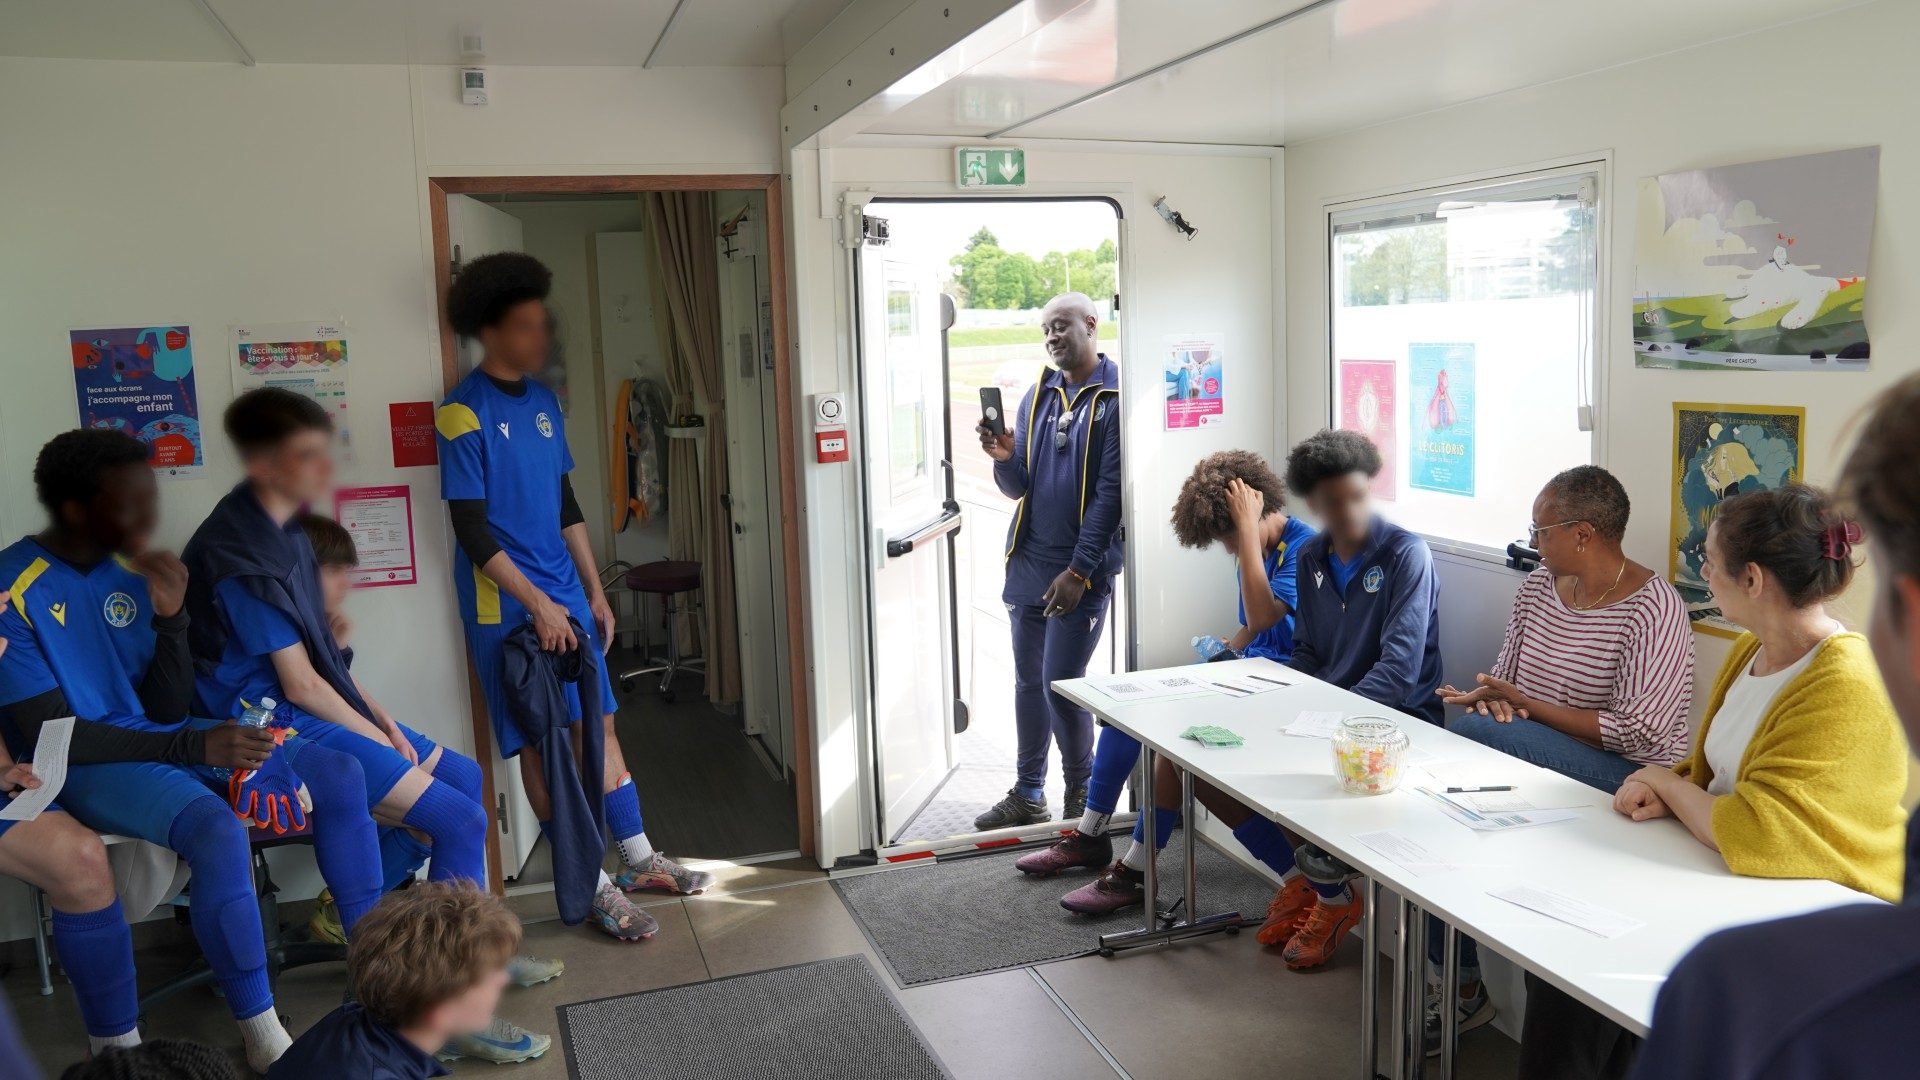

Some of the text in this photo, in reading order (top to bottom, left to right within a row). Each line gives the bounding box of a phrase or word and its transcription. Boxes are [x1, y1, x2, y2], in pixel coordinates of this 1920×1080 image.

[246, 346, 294, 355] Vaccination
[247, 354, 288, 363] êtes-vous
[297, 355, 313, 363] jour
[86, 386, 103, 394] face
[88, 393, 173, 406] j'accompagne mon
[136, 402, 174, 413] enfant
[1430, 442, 1465, 456] CLITORIS
